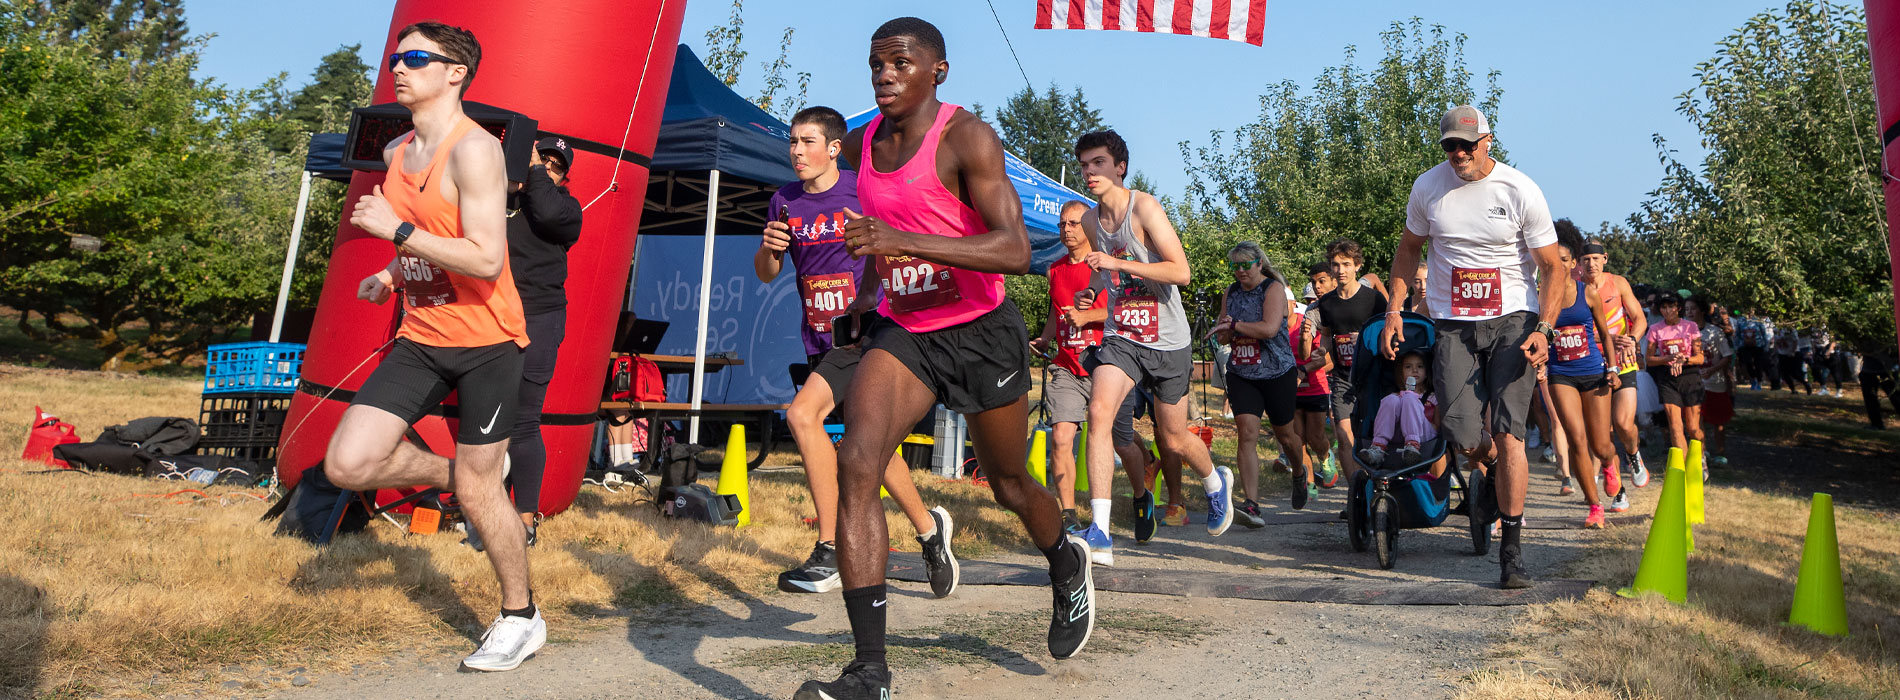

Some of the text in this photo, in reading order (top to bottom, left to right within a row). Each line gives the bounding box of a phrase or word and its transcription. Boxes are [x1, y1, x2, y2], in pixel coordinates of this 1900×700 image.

[401, 256, 433, 281] 356
[892, 264, 938, 295] 422
[1461, 282, 1491, 299] 397
[814, 290, 844, 311] 401
[1121, 309, 1150, 326] 233
[1338, 343, 1354, 356] 126
[1560, 335, 1583, 349] 406
[1236, 345, 1255, 358] 200
